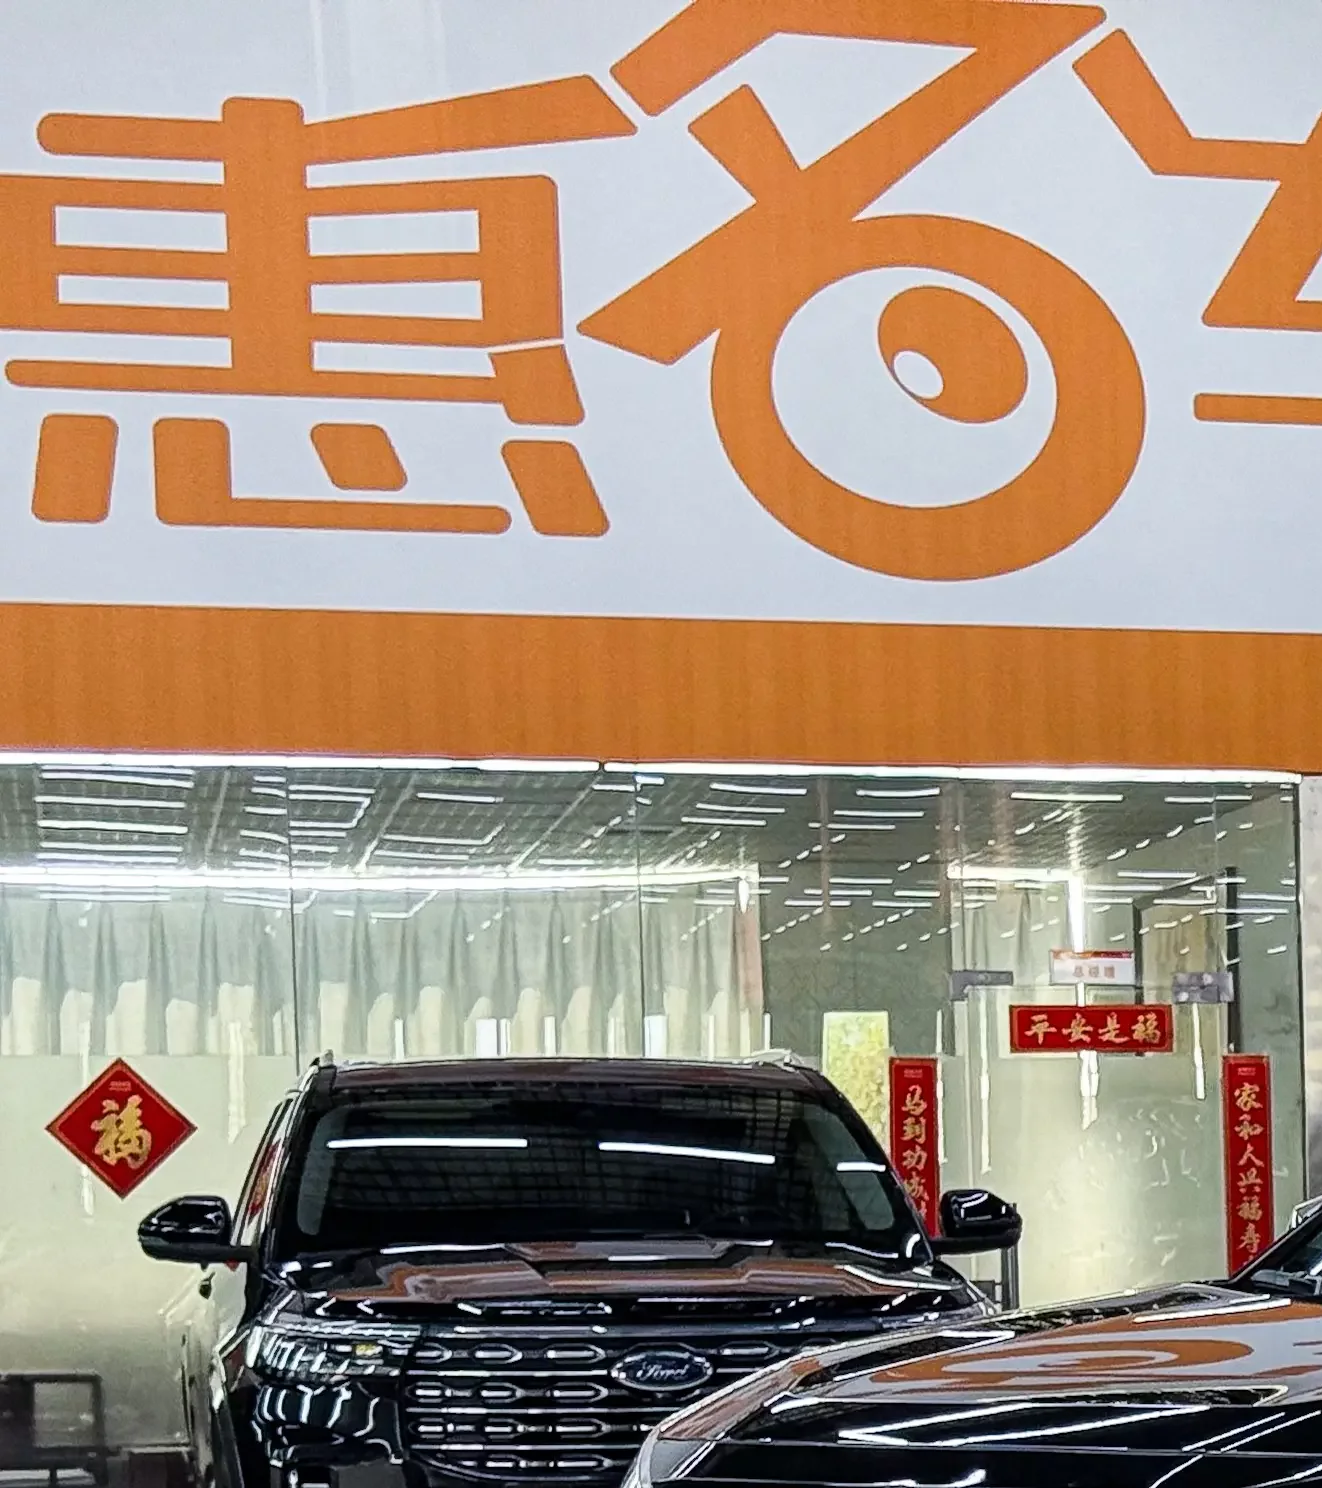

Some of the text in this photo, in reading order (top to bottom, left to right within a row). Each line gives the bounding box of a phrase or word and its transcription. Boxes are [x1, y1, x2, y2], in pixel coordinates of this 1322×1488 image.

[1024, 1011, 1161, 1045] 平安是福
[90, 1094, 152, 1170] 福
[1234, 1082, 1264, 1265] 家和人兴福寿
[636, 1361, 690, 1381] Ford
